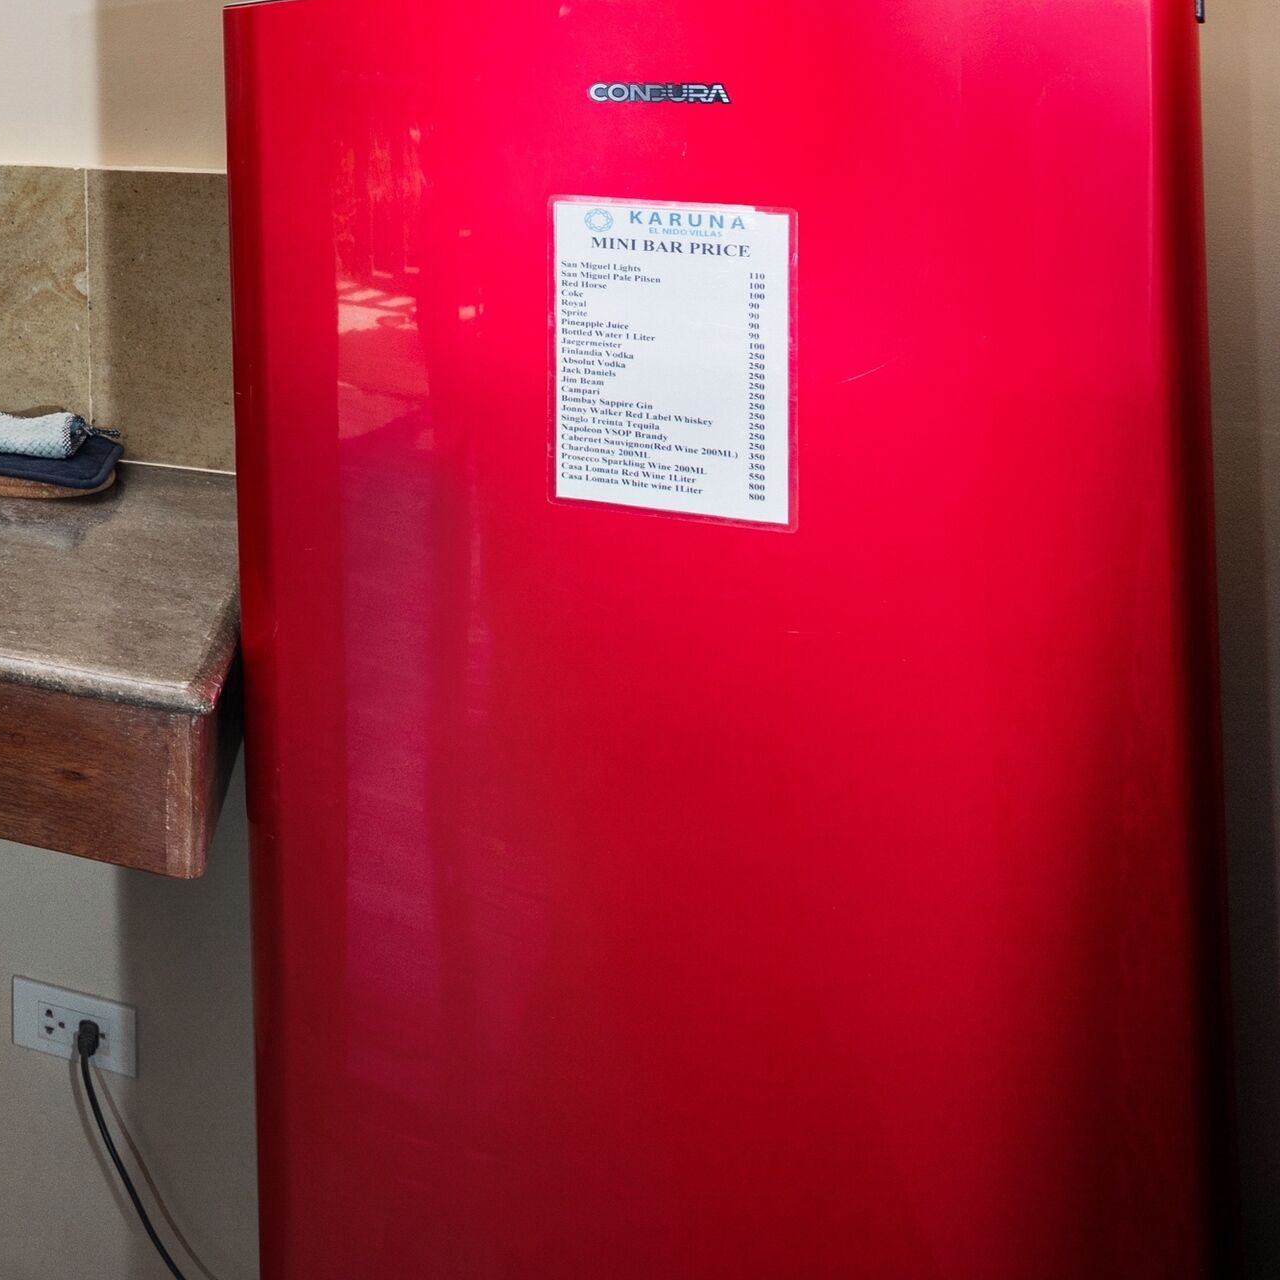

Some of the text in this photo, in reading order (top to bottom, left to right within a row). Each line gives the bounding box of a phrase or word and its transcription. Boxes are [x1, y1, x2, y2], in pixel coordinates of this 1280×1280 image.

[589, 82, 731, 103] CONDURA
[630, 211, 745, 229] KARUNA
[663, 228, 688, 236] NIDO
[689, 229, 722, 237] VILLAS
[591, 237, 750, 257] MINI BAR PRICE
[560, 260, 765, 280] San Miguel Lights 110
[560, 270, 765, 290] San Miguel Pale Pilsen 100
[561, 279, 765, 300] Red Horse 100
[561, 289, 759, 310] Coke 90
[560, 308, 759, 330] Sprite 90
[561, 299, 759, 320] Royal 90
[561, 318, 759, 340] Pineapple Juice 90
[561, 327, 592, 336] Bottled
[594, 330, 623, 339] Water
[633, 333, 655, 342] Liter
[748, 342, 765, 350] 100
[560, 337, 765, 360] Jaegermeister 250
[561, 346, 765, 370] Finlandia Vodka 250
[560, 356, 765, 380] Absolut Vodka 250
[560, 366, 765, 390] Jack Daniels 250
[560, 375, 765, 401] Jim Beam 250
[561, 385, 765, 411] Campari 250
[560, 404, 765, 431] Jonny Walker Red Label Whiskey 250
[561, 394, 596, 406] Bombay
[636, 402, 653, 410] Gin
[748, 412, 765, 421] 250
[561, 423, 765, 451] Napoleon VSOP Brandy 250
[591, 417, 623, 426] Treinta
[626, 420, 660, 430] Tequila
[748, 432, 765, 441] 250
[561, 433, 601, 443] Cabernet
[674, 445, 698, 454] Wine
[748, 452, 765, 461] 350
[561, 442, 765, 471] Chardonnay 200ML 350
[561, 452, 765, 481] Prosecco Sparkling Wine 200ML 550
[561, 461, 582, 470] Casa
[621, 468, 639, 477] Red
[641, 470, 665, 480] Wine
[748, 482, 765, 491] 800
[561, 471, 582, 480] Casa
[621, 478, 648, 488] White
[651, 482, 673, 490] wine
[748, 492, 765, 501] 800
